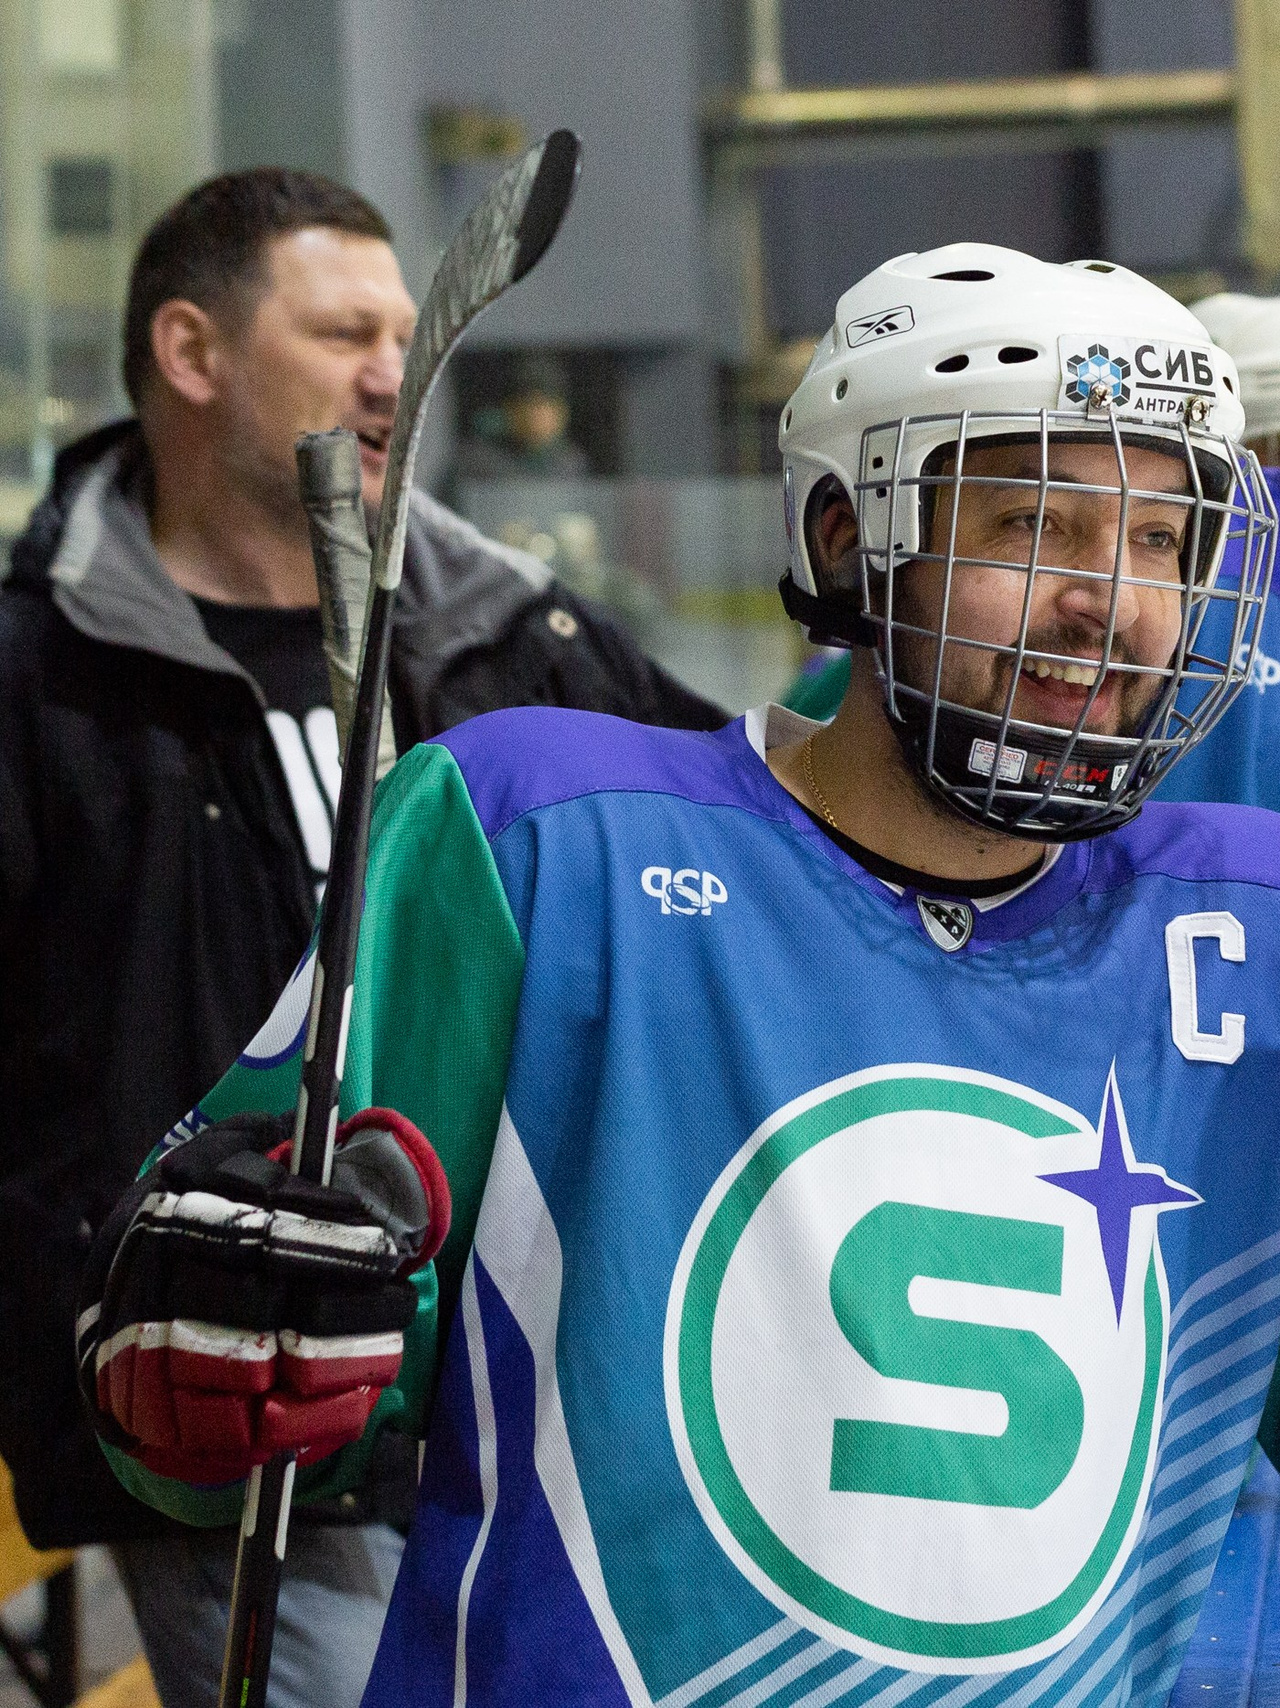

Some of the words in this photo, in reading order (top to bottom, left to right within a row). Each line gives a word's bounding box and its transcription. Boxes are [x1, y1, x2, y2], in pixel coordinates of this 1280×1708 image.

[1135, 345, 1213, 386] СИБ
[1034, 760, 1109, 782] CCM
[1165, 911, 1246, 1065] C
[829, 1200, 1085, 1510] S
